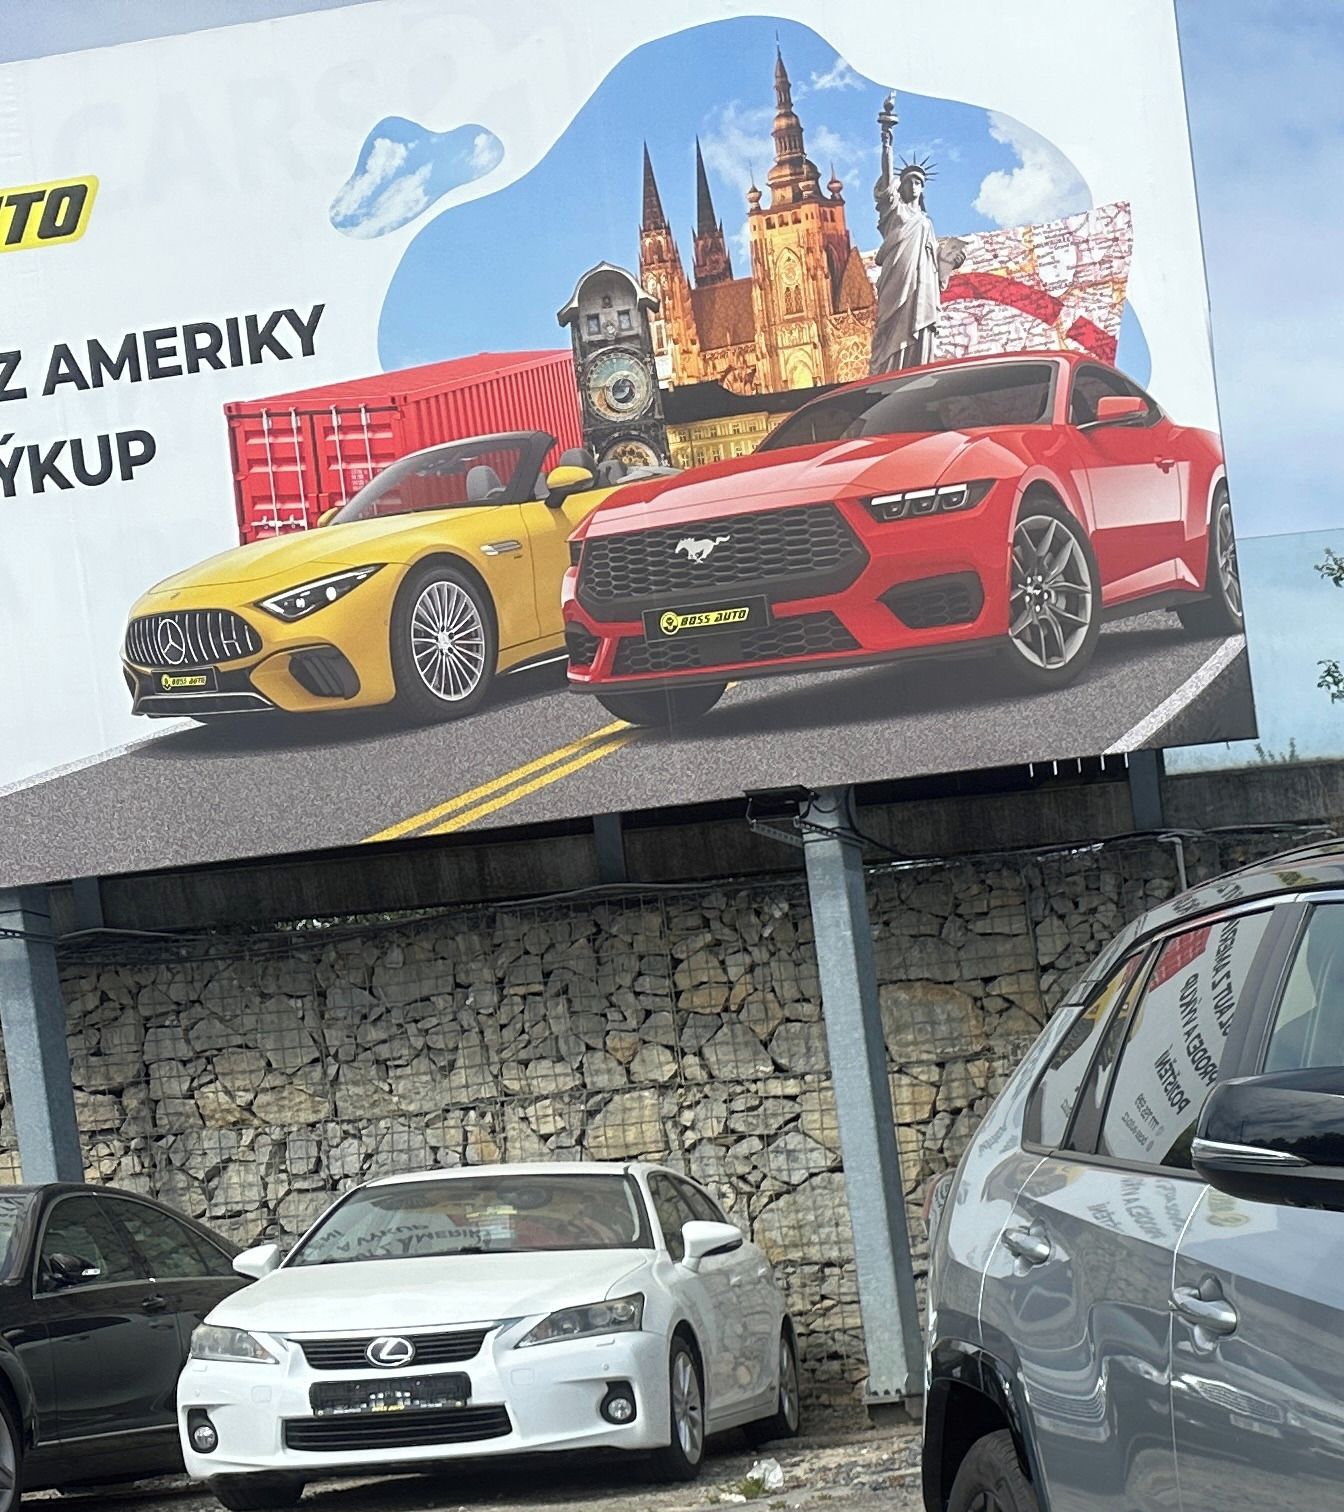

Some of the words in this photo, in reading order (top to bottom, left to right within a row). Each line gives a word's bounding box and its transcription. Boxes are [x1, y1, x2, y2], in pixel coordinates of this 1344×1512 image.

[0, 184, 88, 246] TO
[0, 350, 28, 401] Z
[42, 303, 326, 397] AMERIKY
[680, 614, 711, 627] BOSS
[714, 609, 747, 623] AUTO
